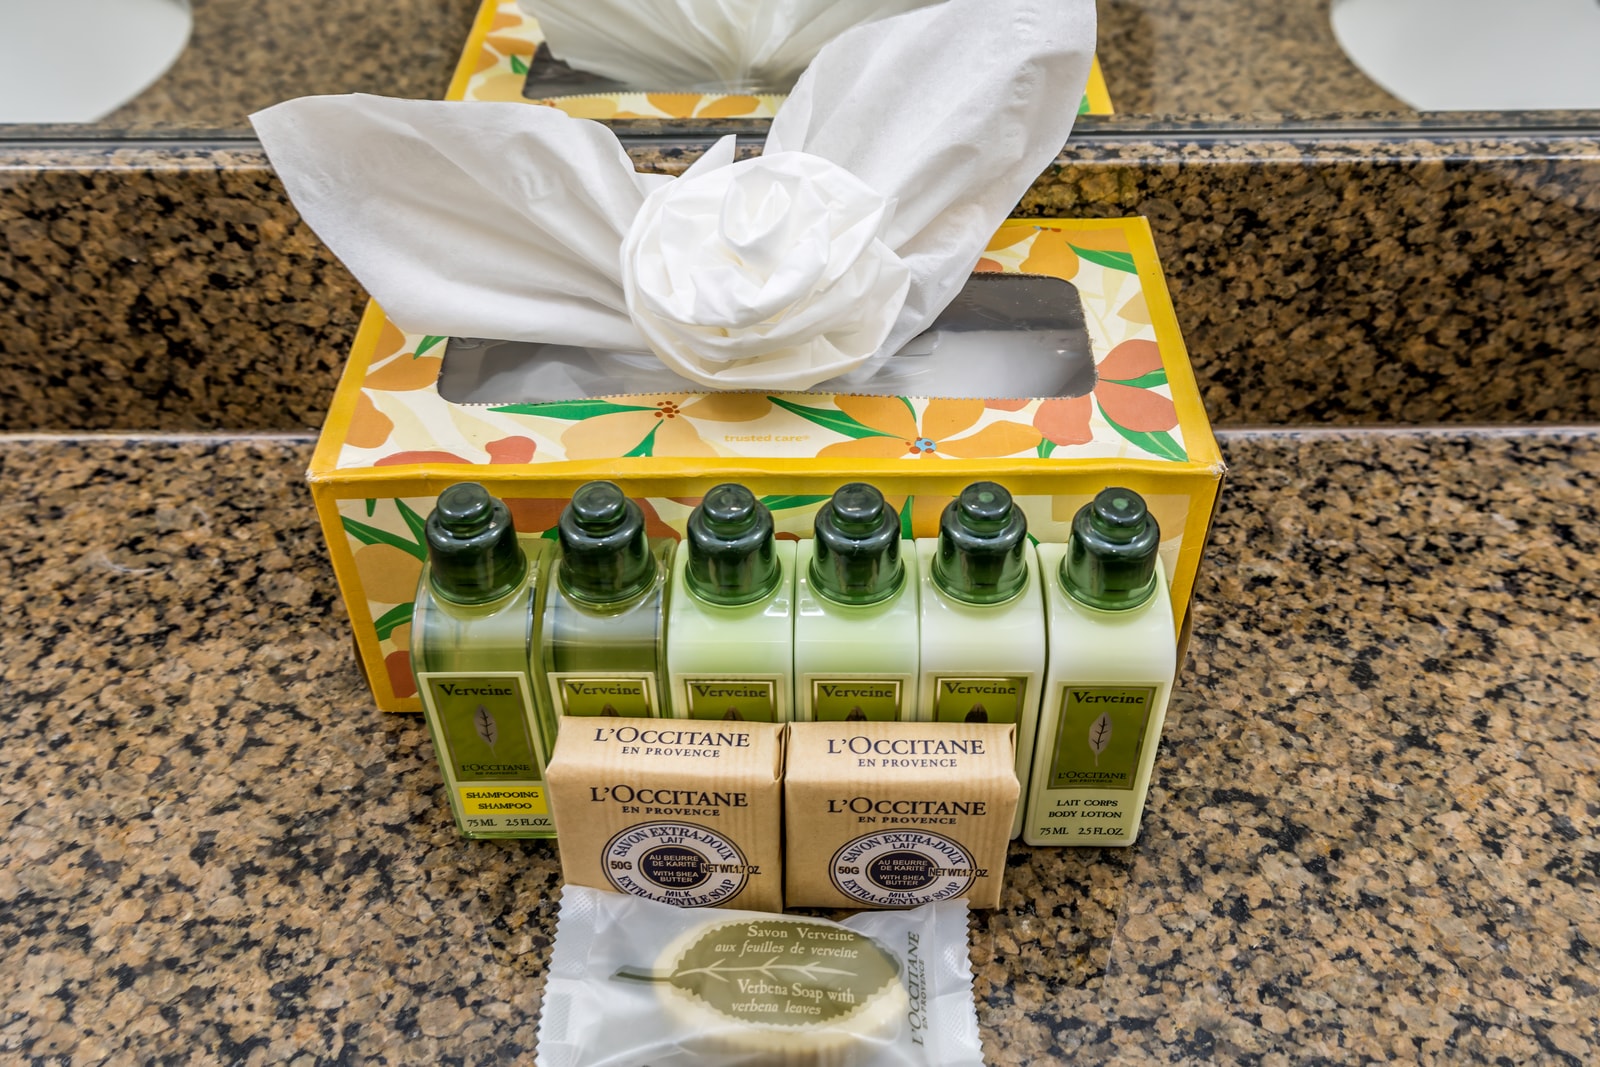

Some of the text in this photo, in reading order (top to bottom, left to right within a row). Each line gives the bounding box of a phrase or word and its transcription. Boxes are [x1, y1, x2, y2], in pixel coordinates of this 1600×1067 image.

[724, 434, 772, 442] trusted
[438, 684, 513, 696] Verveine
[568, 683, 641, 695] Verveine
[695, 685, 768, 698] Verveine
[821, 685, 893, 698] Verveine
[944, 682, 1017, 695] Verveine
[1073, 692, 1145, 704] Verveine
[593, 726, 750, 748] L'OCCITANE
[827, 736, 985, 755] L'OCCITANE
[622, 746, 720, 758] EN PROVENCE
[461, 763, 531, 773] L'OCCITANE
[858, 758, 958, 768] EN PROVENCE
[1057, 771, 1127, 780] L'OCCITANE
[466, 791, 540, 799] SHAMPOOING
[590, 784, 749, 807] L'OCCITANE
[478, 802, 532, 810] SHAMPOO
[827, 796, 987, 816] L'OCCITANE
[1056, 799, 1119, 807] LAIT CORPS
[645, 807, 721, 817] PROVENCE
[467, 819, 479, 827] 75
[480, 819, 497, 827] ML
[858, 816, 957, 825] EN PROVENCE
[1039, 827, 1051, 836] 75
[1052, 827, 1069, 835] ML
[612, 826, 736, 862] SAVON EXTRA-DOUX
[659, 837, 685, 845] LAIT
[892, 842, 918, 850] LAIT
[842, 833, 967, 866] SAVON EXTRA-DOUX
[663, 854, 699, 862] BEURRE
[610, 861, 633, 871] 50G
[701, 862, 719, 874] NET
[838, 866, 860, 875] 50G
[928, 866, 947, 878] NET
[675, 870, 699, 878] SHEA
[617, 875, 736, 907] EXTRA-GENTLE SOAP
[665, 889, 692, 898] MILK
[842, 879, 961, 905] EXTRA-GENTLE SOAP
[747, 925, 855, 941] Savon Verveine
[715, 941, 858, 959] aux feuilles de verveine
[737, 978, 856, 1004] Verbena Soap with
[906, 930, 924, 1048] L'OCCITANE
[919, 959, 929, 1030] EN PROVENCE
[731, 1000, 822, 1015] verbena leaves
